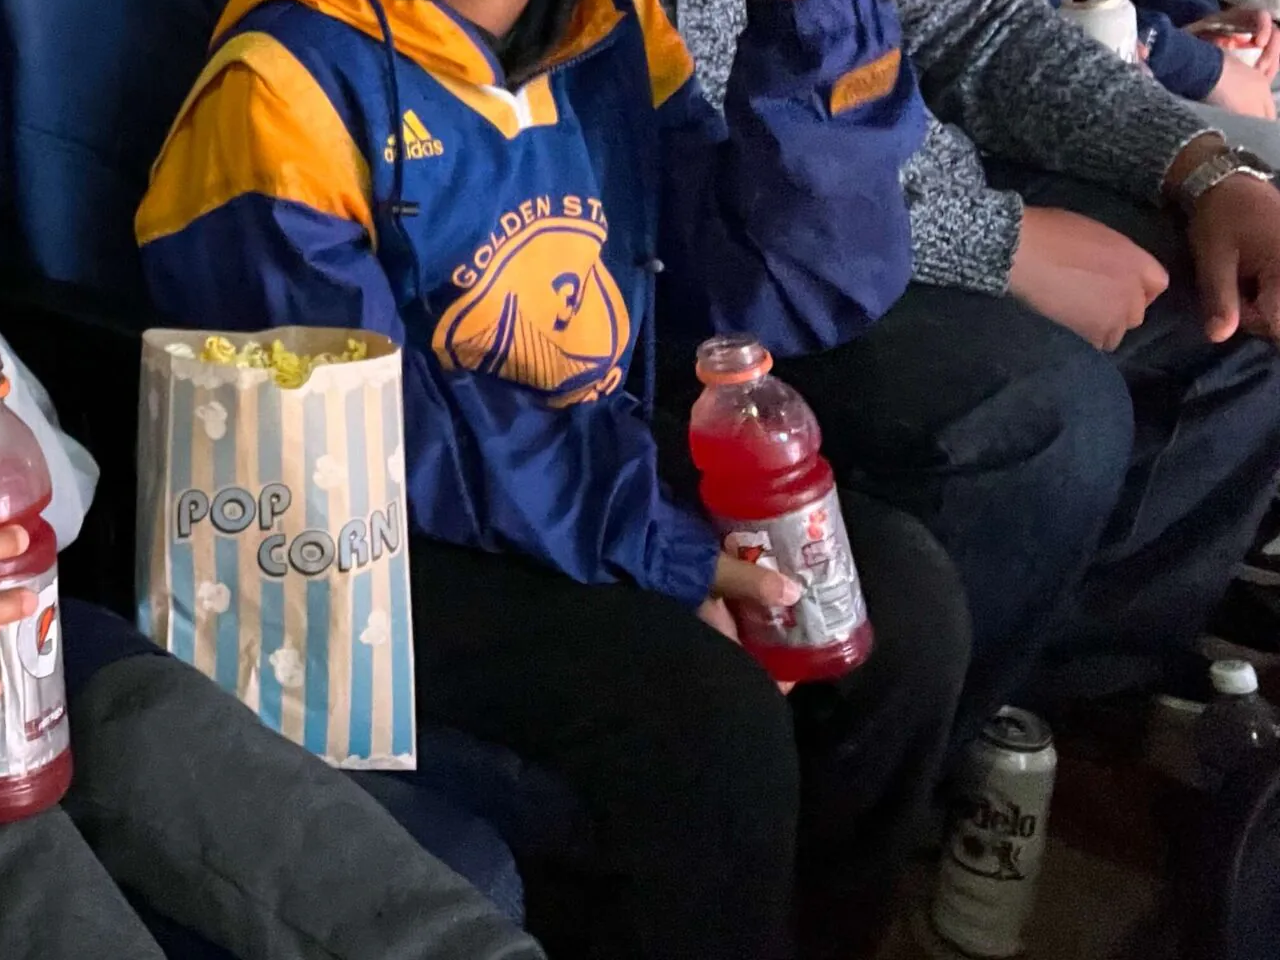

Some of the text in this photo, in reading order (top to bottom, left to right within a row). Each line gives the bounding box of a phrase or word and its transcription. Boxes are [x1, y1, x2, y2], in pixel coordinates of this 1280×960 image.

[384, 139, 444, 164] aidas
[451, 194, 552, 288] GOLDEN
[177, 482, 293, 539] POP
[257, 503, 402, 577] CORN
